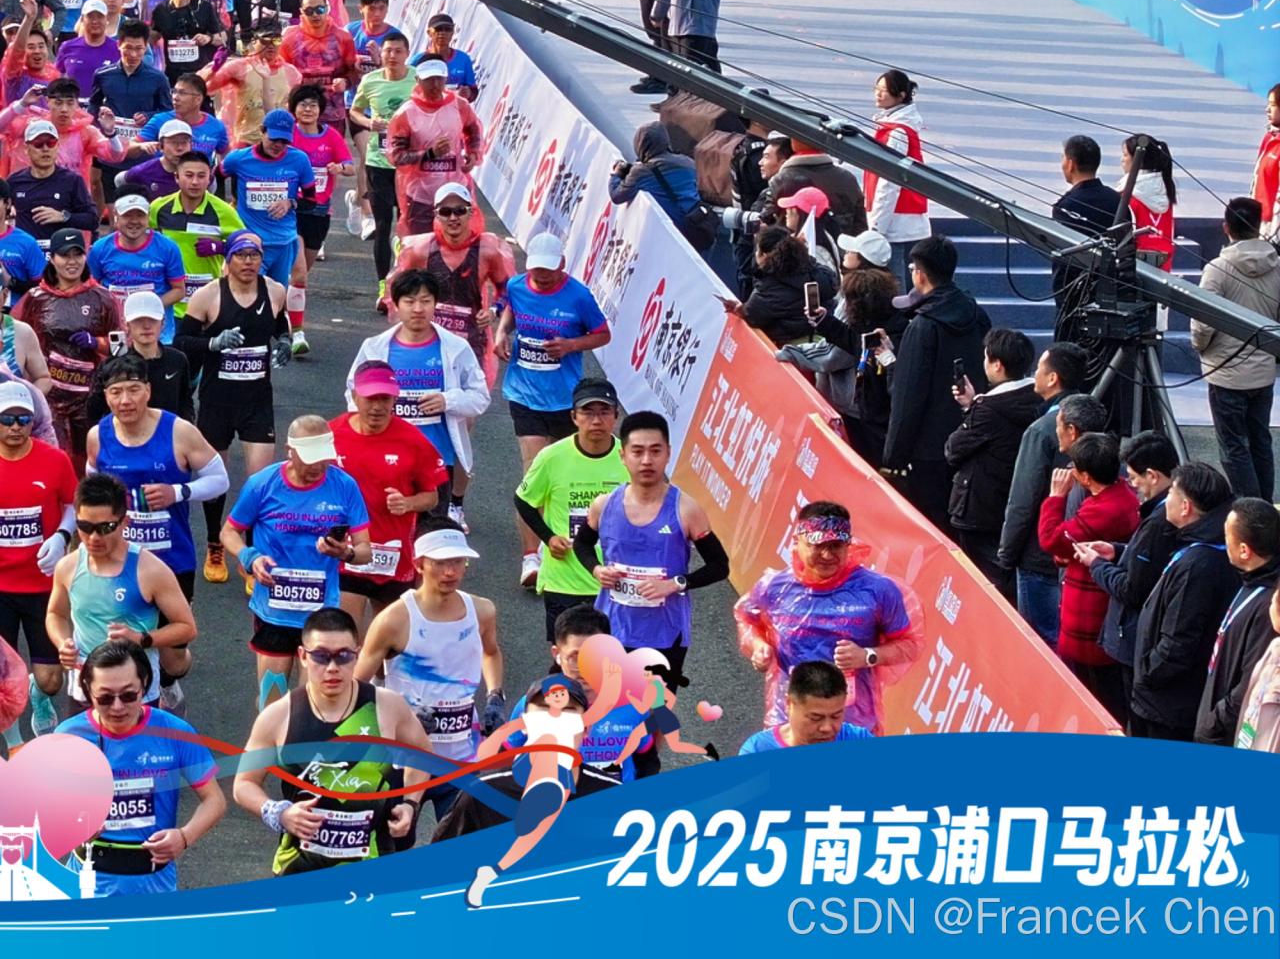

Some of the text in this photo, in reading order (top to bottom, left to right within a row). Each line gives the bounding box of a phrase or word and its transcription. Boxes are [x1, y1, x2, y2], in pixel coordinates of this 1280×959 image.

[600, 221, 639, 303] 南京银行
[653, 300, 701, 396] 南京银行
[224, 359, 263, 372] B07309
[122, 526, 166, 541] B05116
[273, 582, 320, 599] B05789
